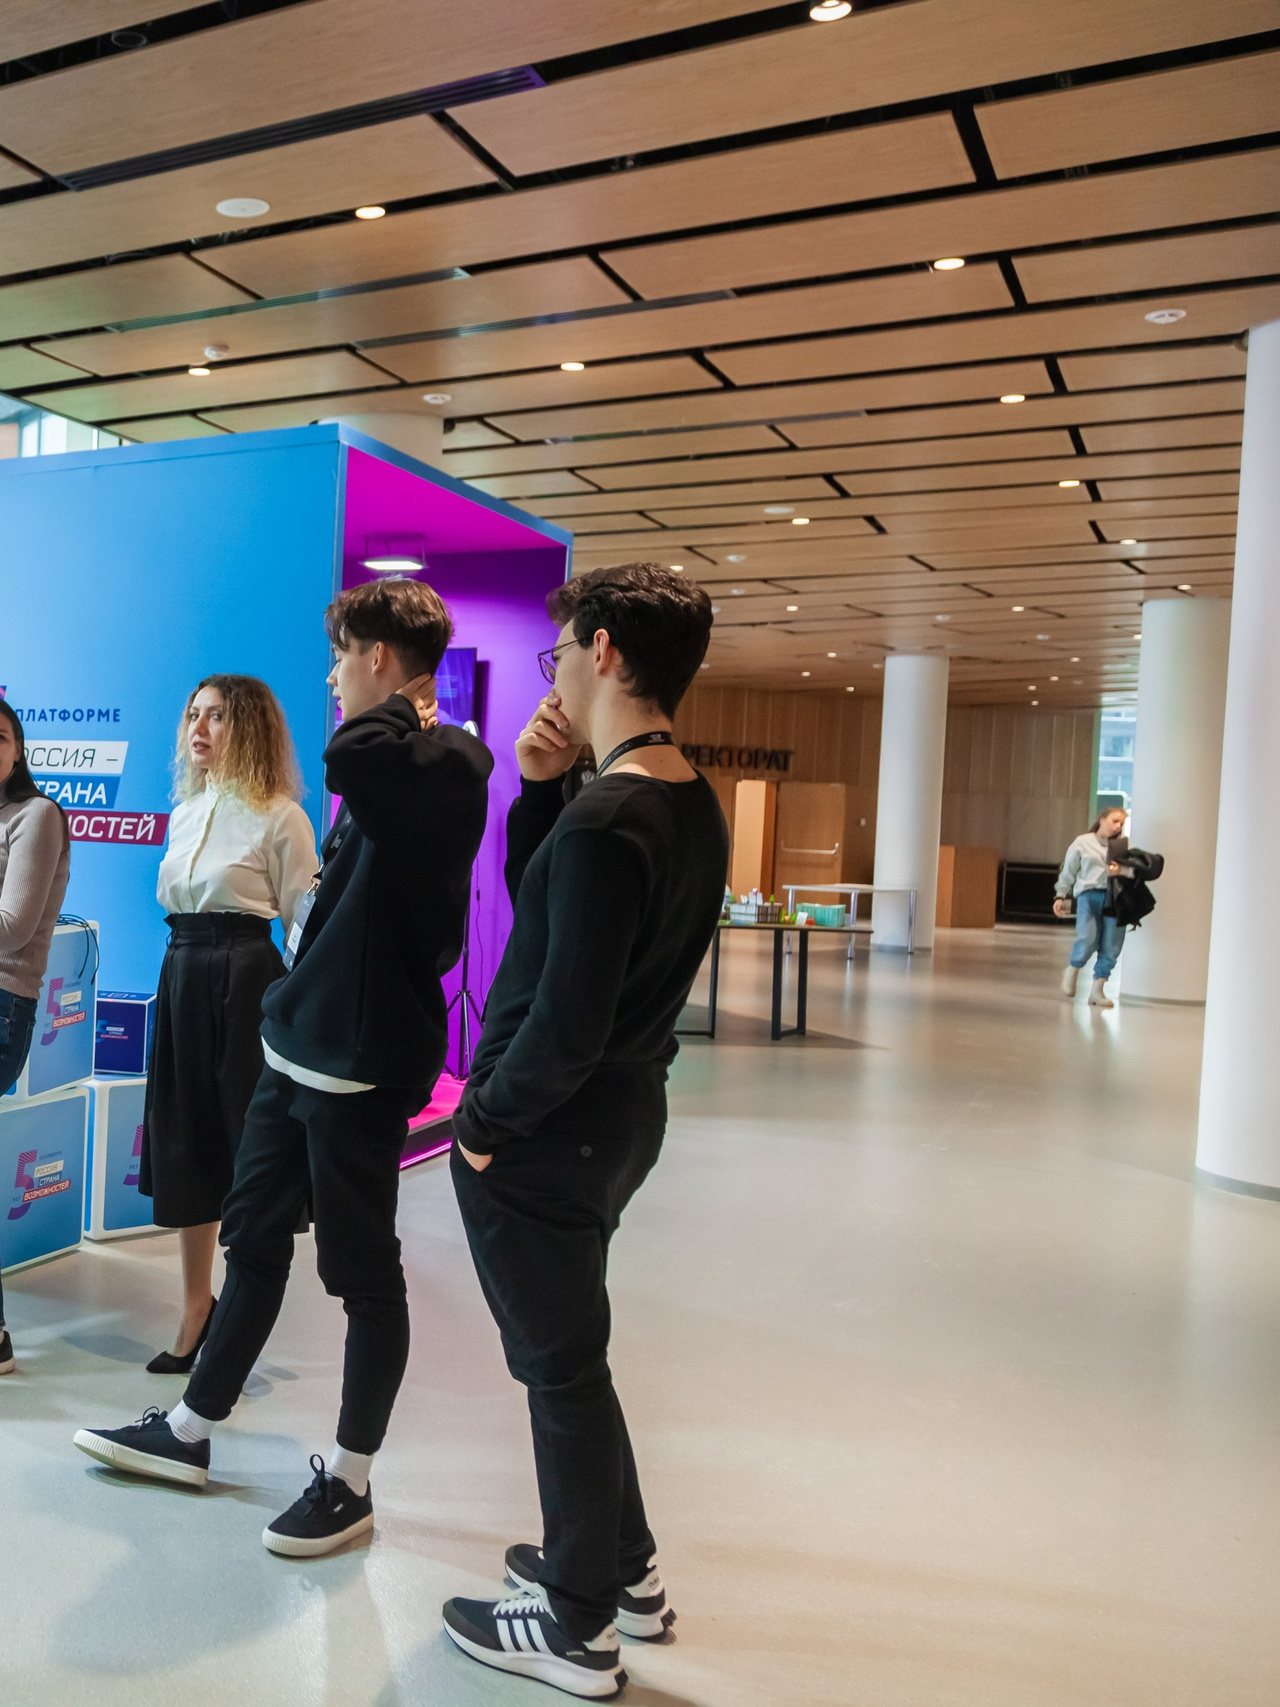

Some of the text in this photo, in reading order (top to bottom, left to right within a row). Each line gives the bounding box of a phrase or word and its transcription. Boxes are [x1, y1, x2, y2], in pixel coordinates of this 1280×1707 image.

[15, 708, 121, 722] ПЛАТФОРМЕ
[68, 814, 156, 841] ОСТЕЙ
[38, 1174, 60, 1187] СТРАНА
[23, 1180, 69, 1201] ВОЗМОЖНОСТЕЙ
